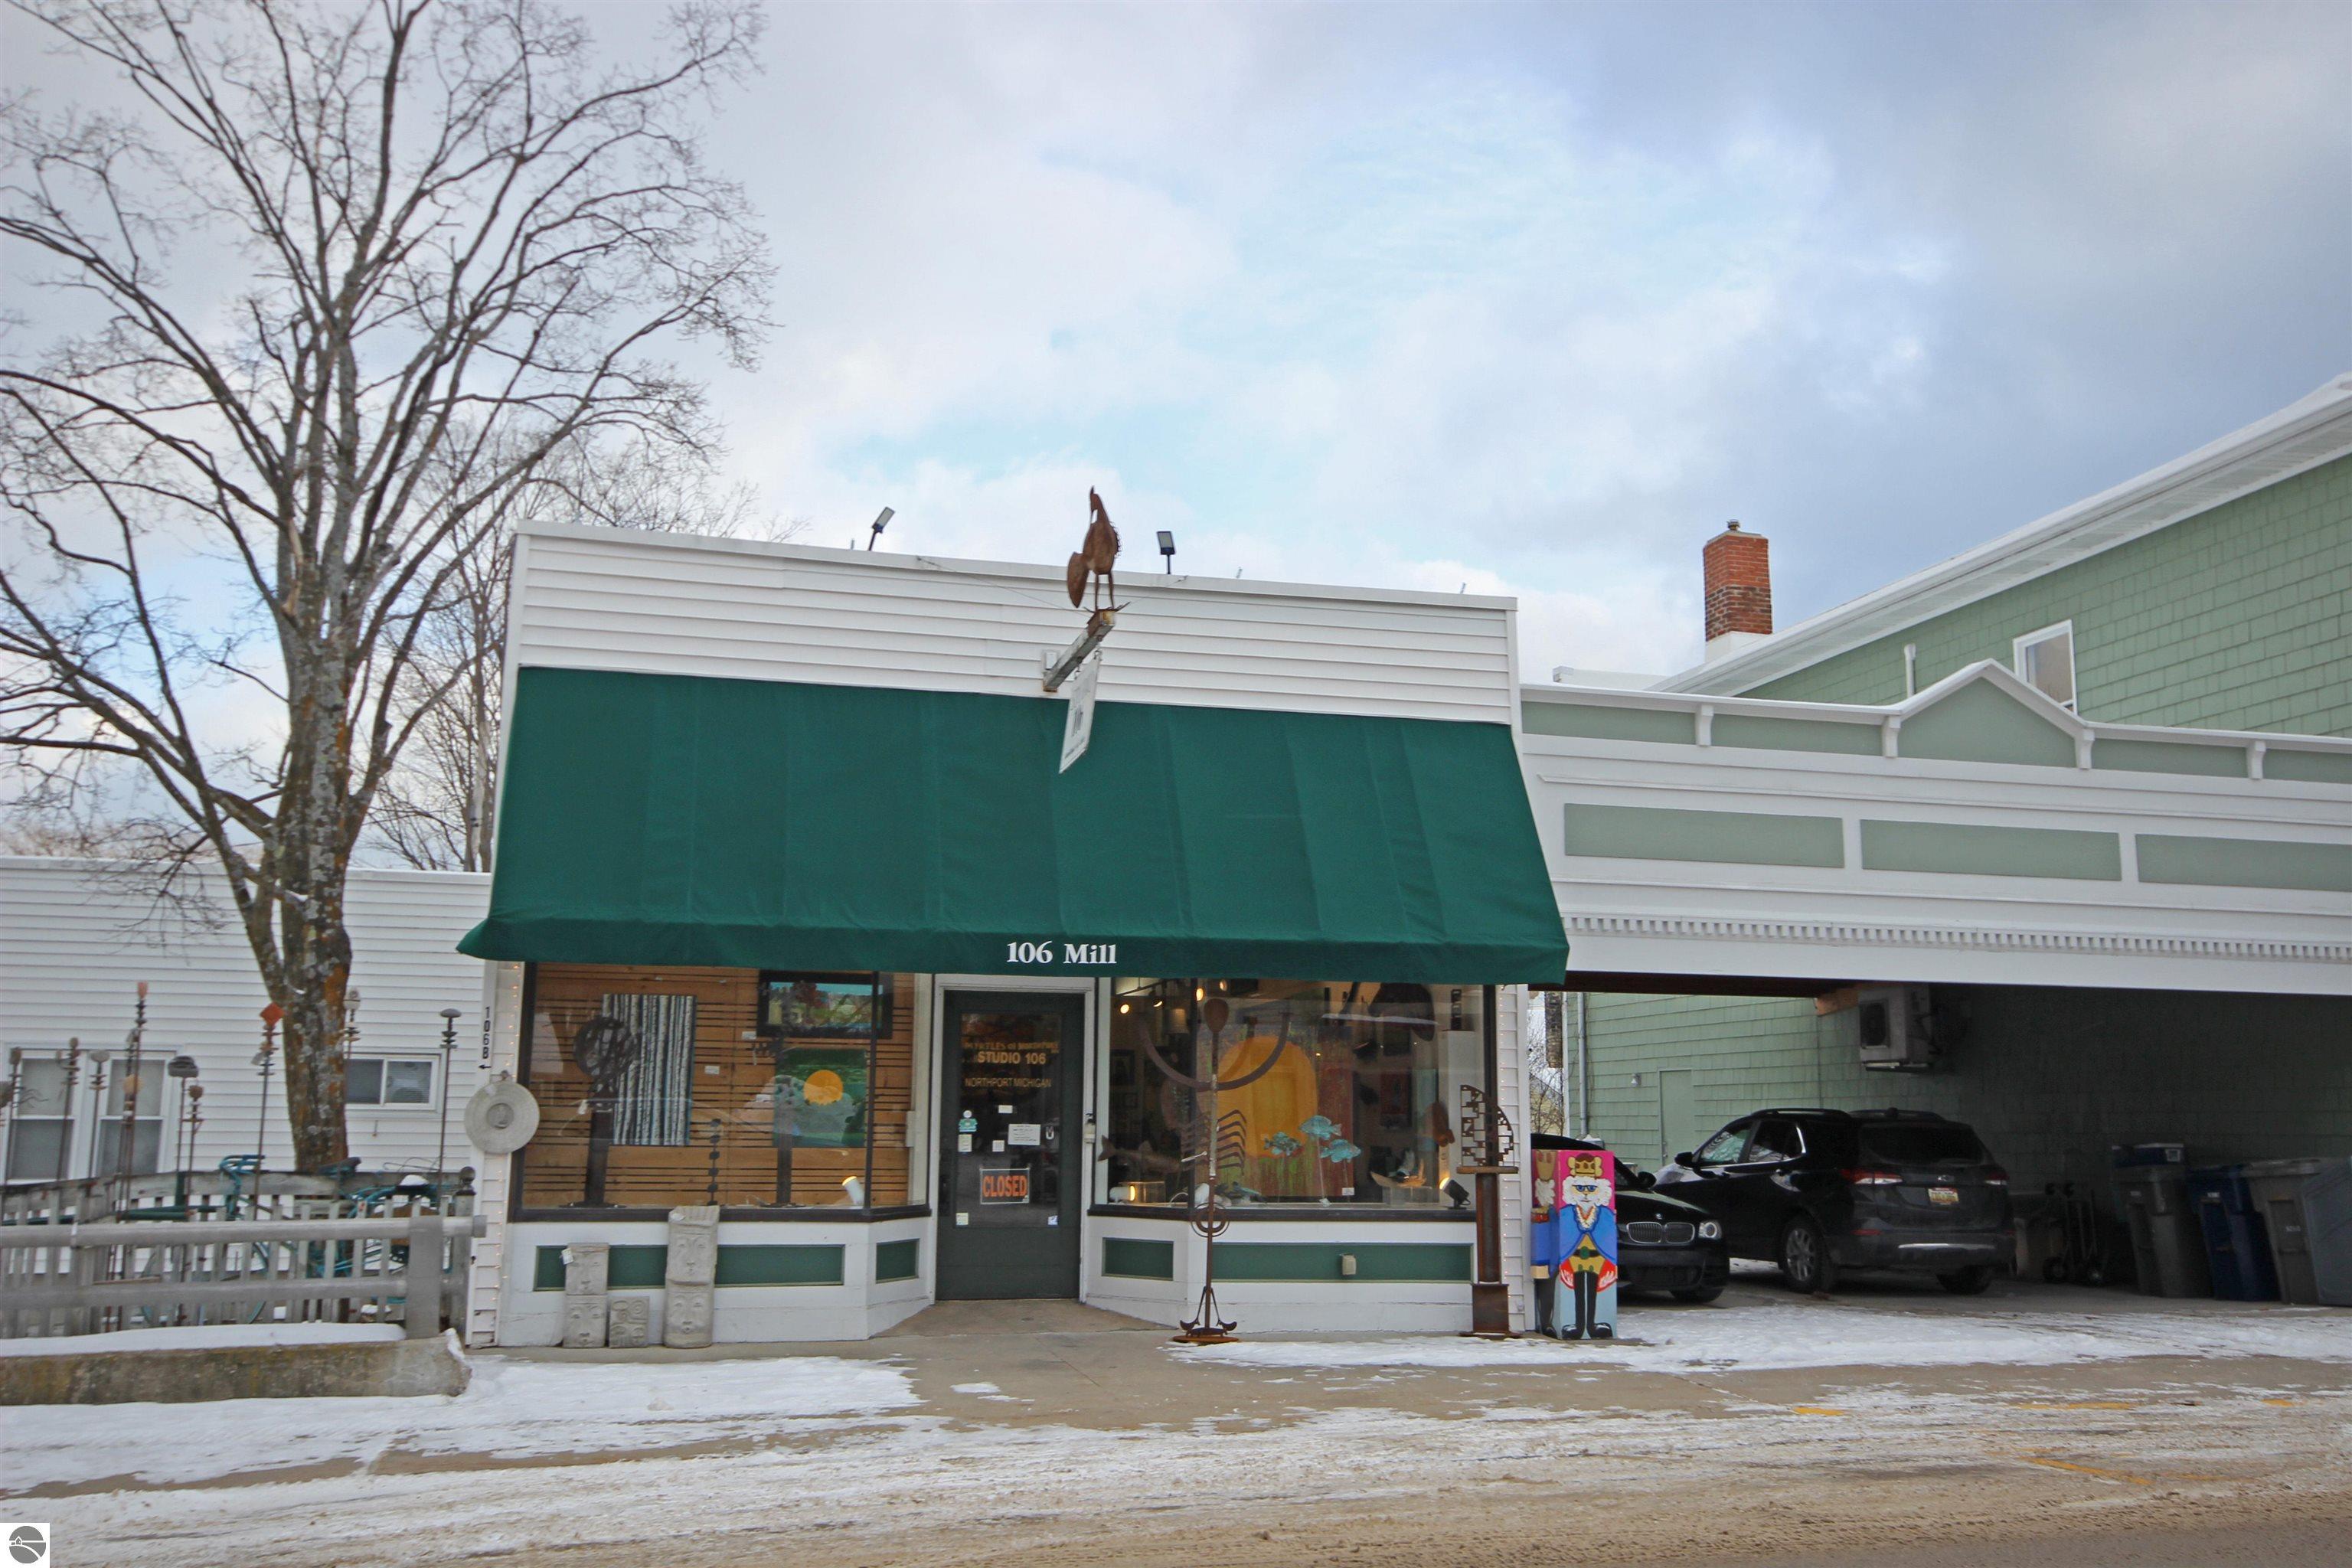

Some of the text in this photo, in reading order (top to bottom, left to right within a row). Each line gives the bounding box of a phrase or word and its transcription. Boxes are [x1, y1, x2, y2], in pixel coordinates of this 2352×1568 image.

[1006, 940, 1118, 965] 106 Mill
[977, 1051, 1047, 1065] STUDIO 106
[965, 1077, 1053, 1088] NORTHPORT MICHIGAN
[982, 1175, 1027, 1197] CLOSED
